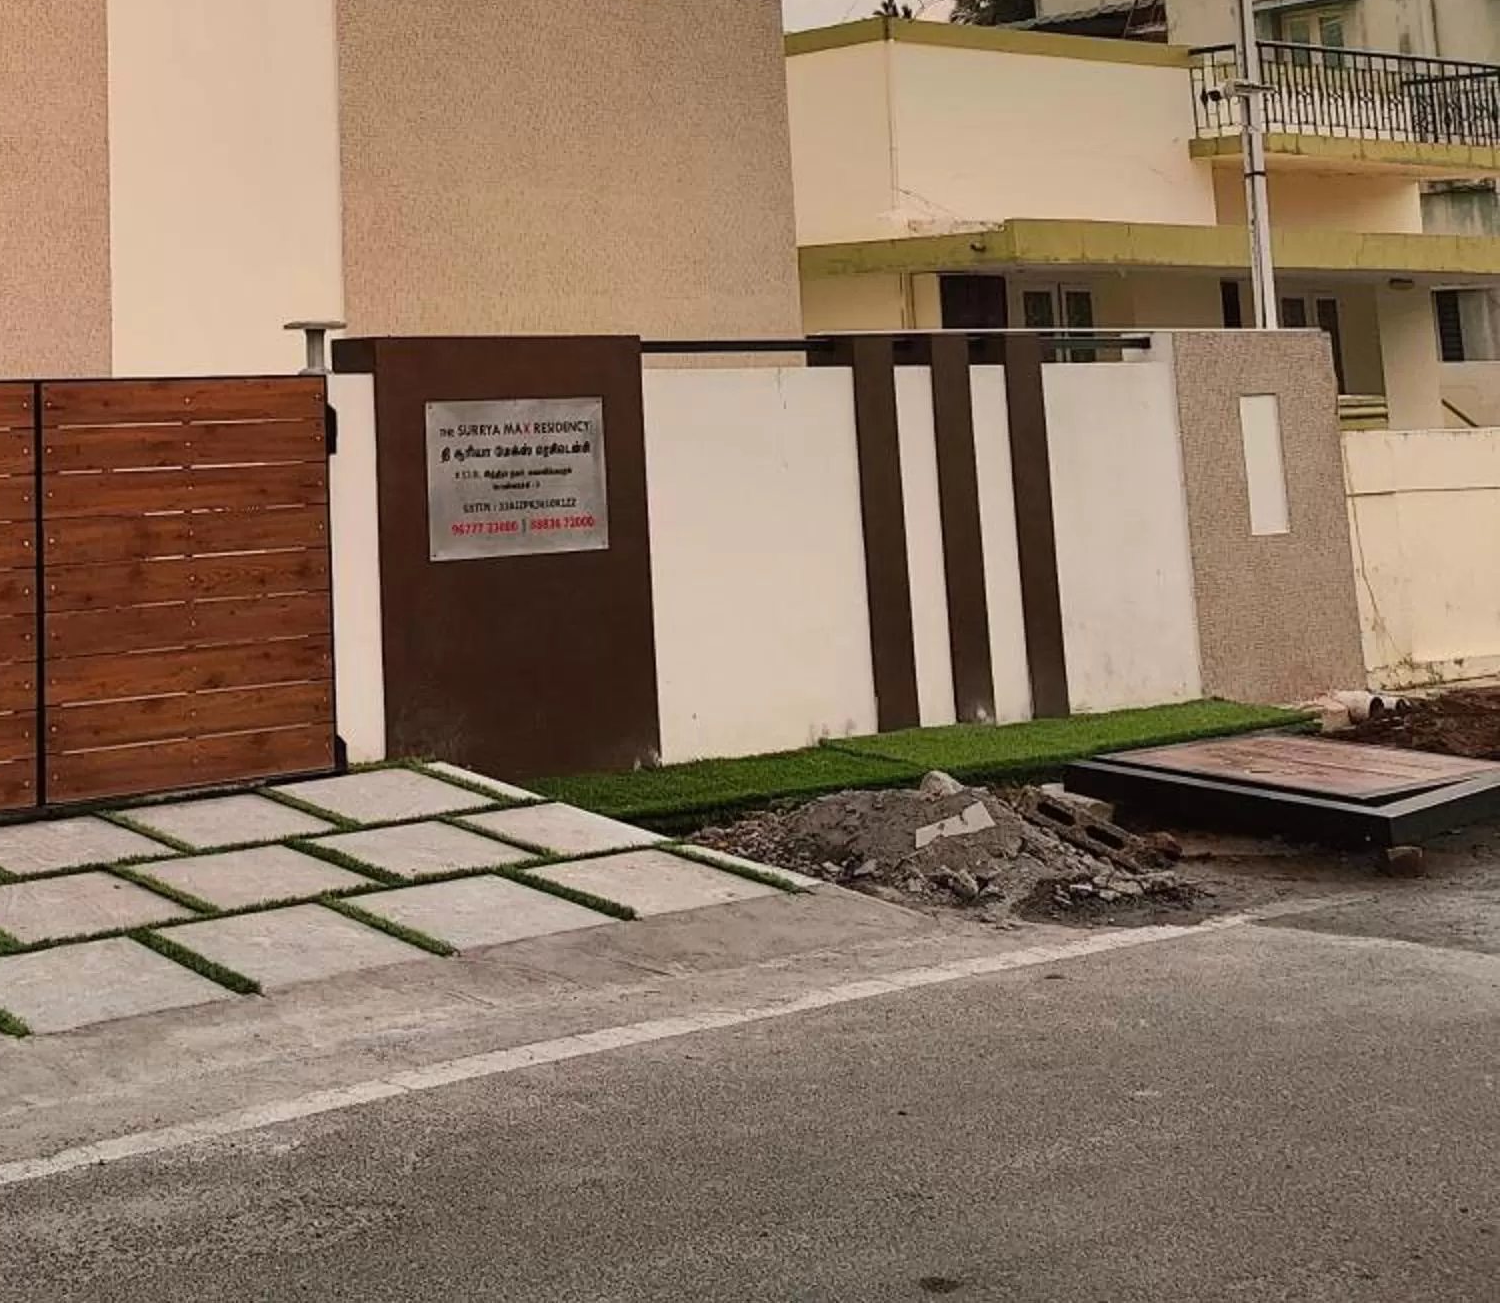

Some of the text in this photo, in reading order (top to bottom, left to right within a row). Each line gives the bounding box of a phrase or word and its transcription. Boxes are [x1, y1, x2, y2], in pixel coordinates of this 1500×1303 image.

[457, 424, 501, 437] SURRYA
[503, 422, 532, 436] MAX
[533, 420, 592, 435] RESIDENCY
